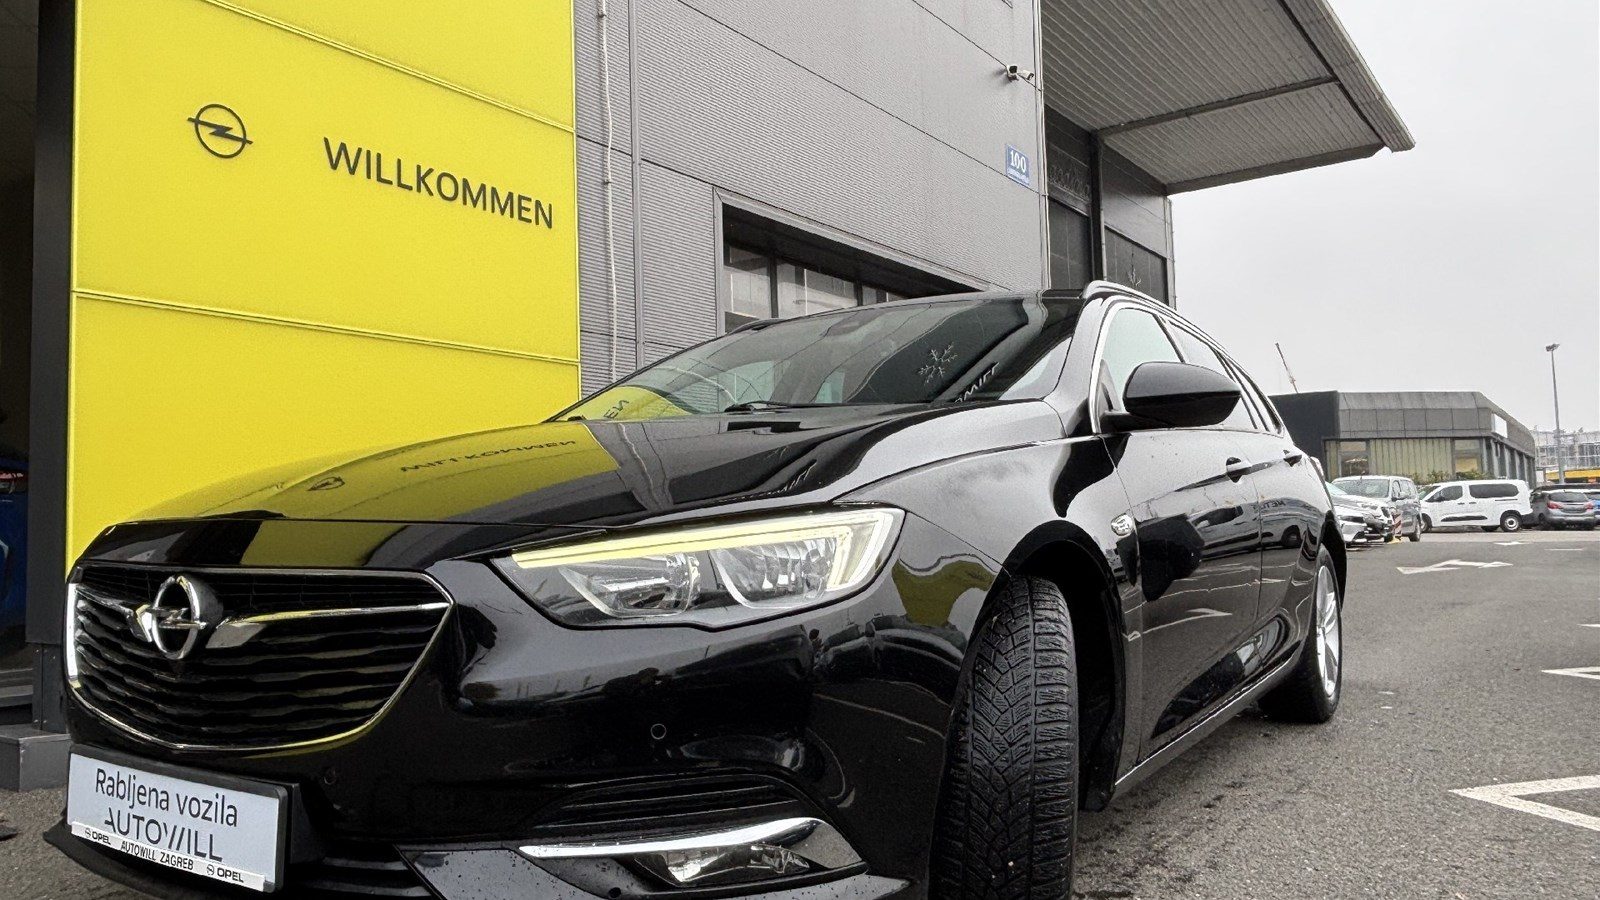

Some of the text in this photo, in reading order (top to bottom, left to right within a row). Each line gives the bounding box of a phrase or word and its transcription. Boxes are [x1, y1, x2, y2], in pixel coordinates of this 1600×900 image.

[323, 136, 553, 230] WILLKOMMEN
[1010, 149, 1027, 174] 100
[95, 767, 238, 828] Rabljena vozila
[91, 830, 244, 883] OPEL AUTOWILL ZAGREB OPEL
[104, 806, 223, 863] AUTOWILL
